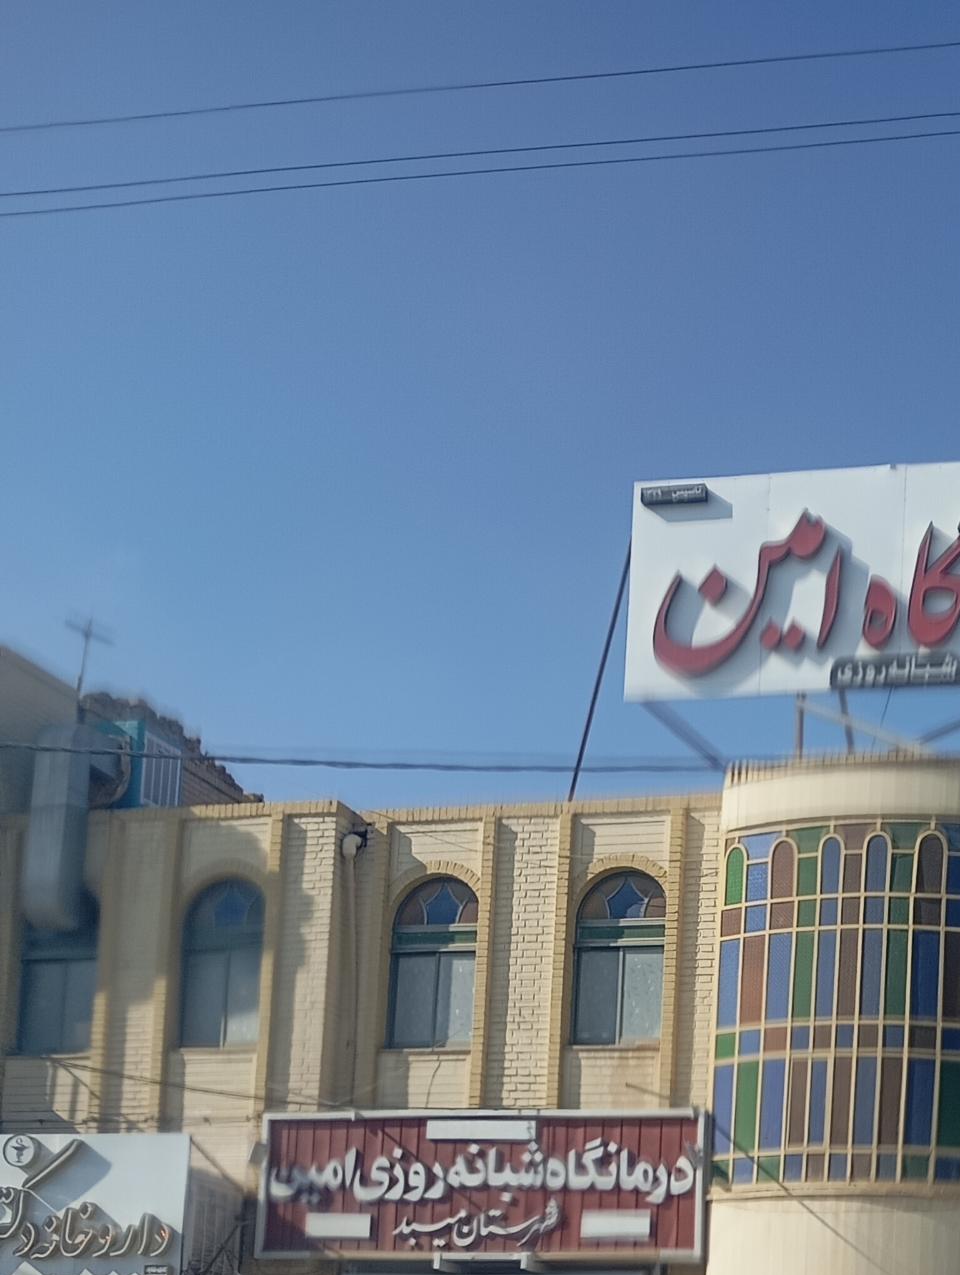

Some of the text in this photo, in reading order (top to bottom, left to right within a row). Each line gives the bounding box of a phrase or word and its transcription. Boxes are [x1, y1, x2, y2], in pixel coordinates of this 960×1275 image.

[652, 507, 843, 678] امین
[269, 1137, 695, 1205] درمانگاه شبانه روزی امین
[30, 1202, 173, 1259] داروخانه
[392, 1197, 560, 1247] شهرستان میبد
